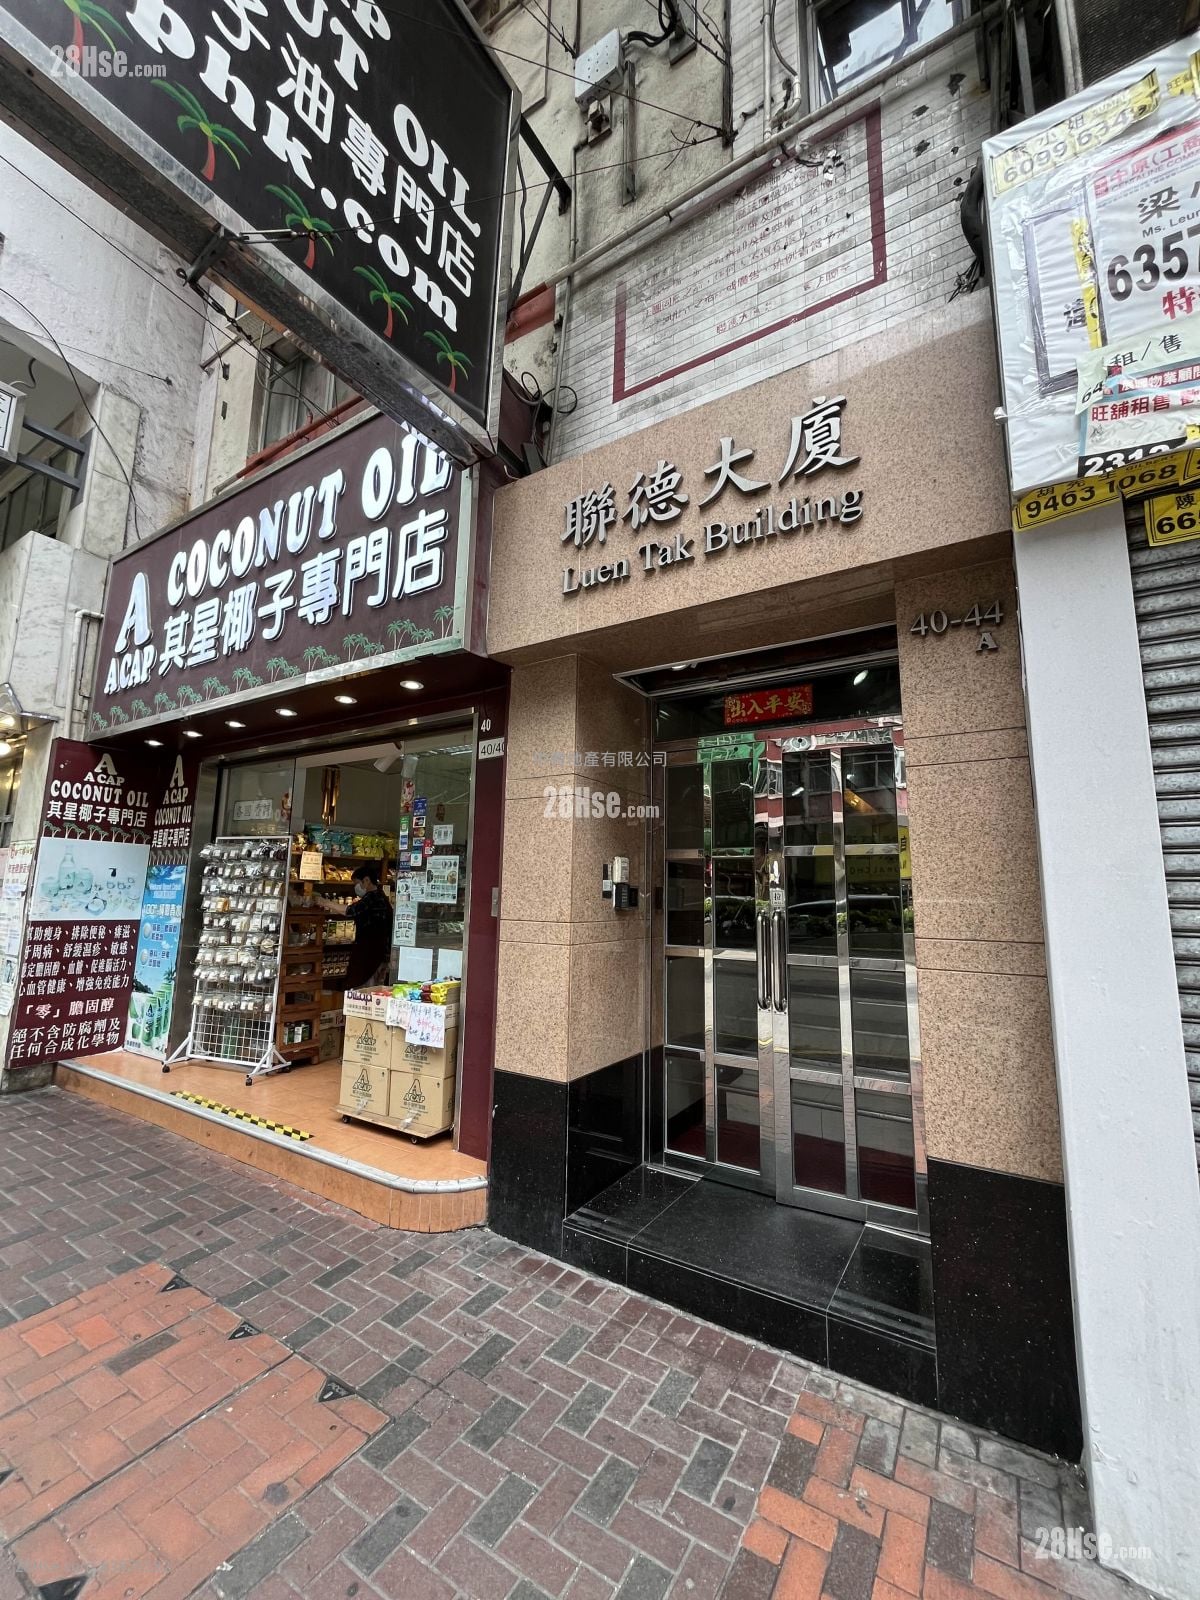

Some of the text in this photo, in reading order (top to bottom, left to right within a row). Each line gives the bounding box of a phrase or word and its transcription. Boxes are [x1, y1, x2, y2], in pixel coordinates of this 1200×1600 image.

[394, 103, 481, 238] OIL
[1003, 141, 1068, 184] 6099
[1142, 223, 1166, 238] Ms.
[560, 394, 862, 548] 聯德大廈
[1083, 444, 1170, 478] 231
[1025, 464, 1178, 520] 9463 1068
[167, 433, 453, 606] COCONUT OIL
[1156, 511, 1200, 535] 66
[561, 488, 863, 595] Luen Tak Building
[158, 509, 449, 676] 其星椰子專門店
[115, 572, 151, 653] A
[910, 600, 1005, 636] 40-44
[976, 632, 999, 652] A
[104, 645, 157, 695] ACAP
[481, 718, 492, 733] 40
[94, 753, 118, 776] A
[169, 754, 185, 788] A
[50, 779, 149, 808] COCONUT OIL
[47, 800, 148, 828] 其星椰子專門店
[154, 805, 192, 826] COCONUT OIL
[151, 827, 191, 848] 其星椰子專門店
[10, 1031, 120, 1061] 任何合成化學物
[12, 1017, 121, 1044] 絕不含防腐劑及
